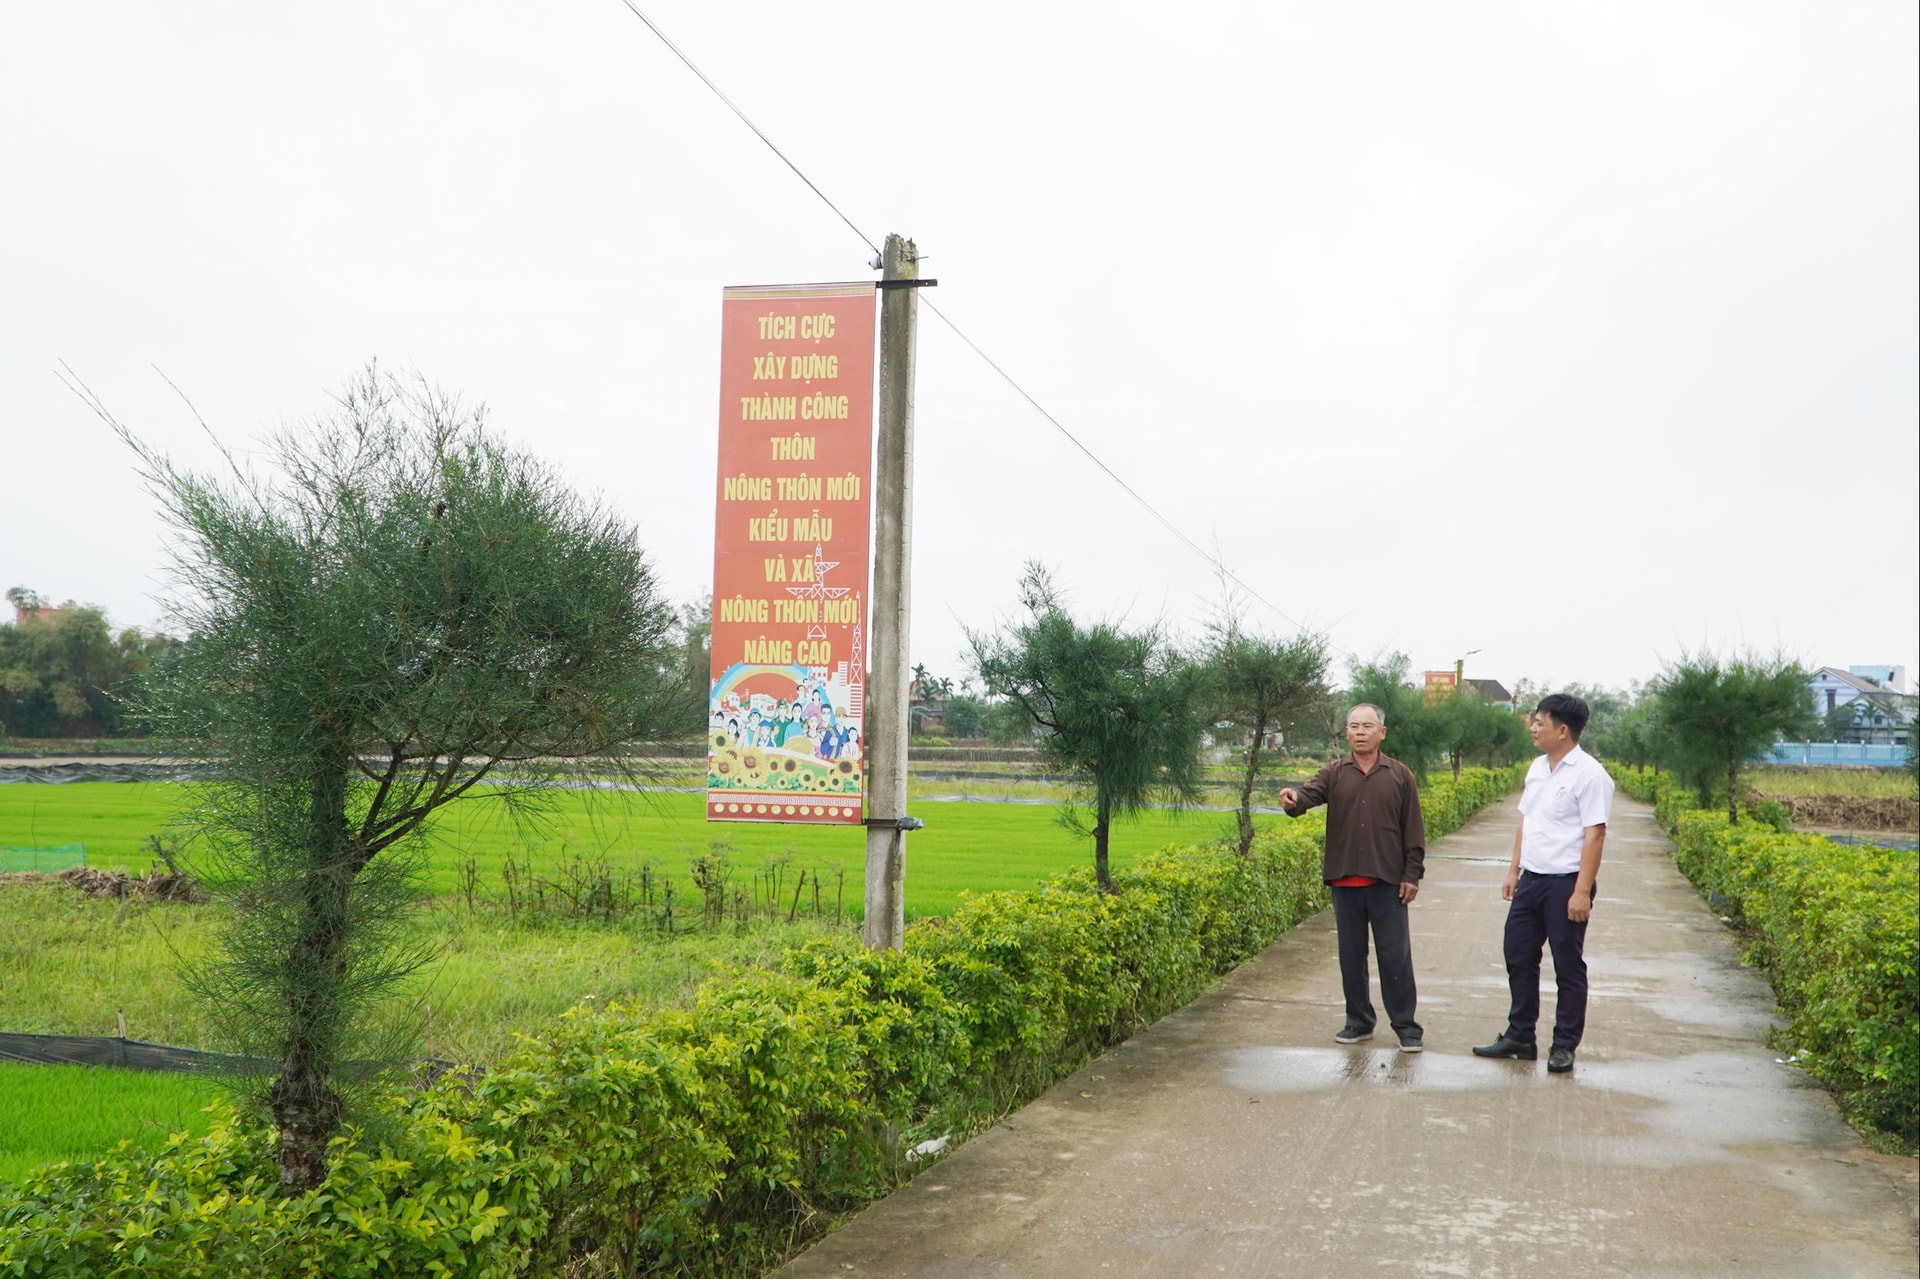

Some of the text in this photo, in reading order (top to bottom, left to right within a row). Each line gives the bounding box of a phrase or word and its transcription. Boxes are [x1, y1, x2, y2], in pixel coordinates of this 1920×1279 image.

[758, 312, 836, 344] TÍCH CỰC
[753, 351, 838, 384] XÂY DỰNG
[741, 391, 848, 421] THÀNH CÔNG
[770, 432, 815, 461] THÔN
[724, 472, 860, 501] NÔNG THÔN MỚI
[749, 508, 832, 542] KIỂU MẪU
[764, 554, 815, 583] VÀ XÃ
[720, 595, 768, 623] NÔNG
[773, 594, 818, 623] THÔN
[744, 635, 832, 665] NÂNG CAO
